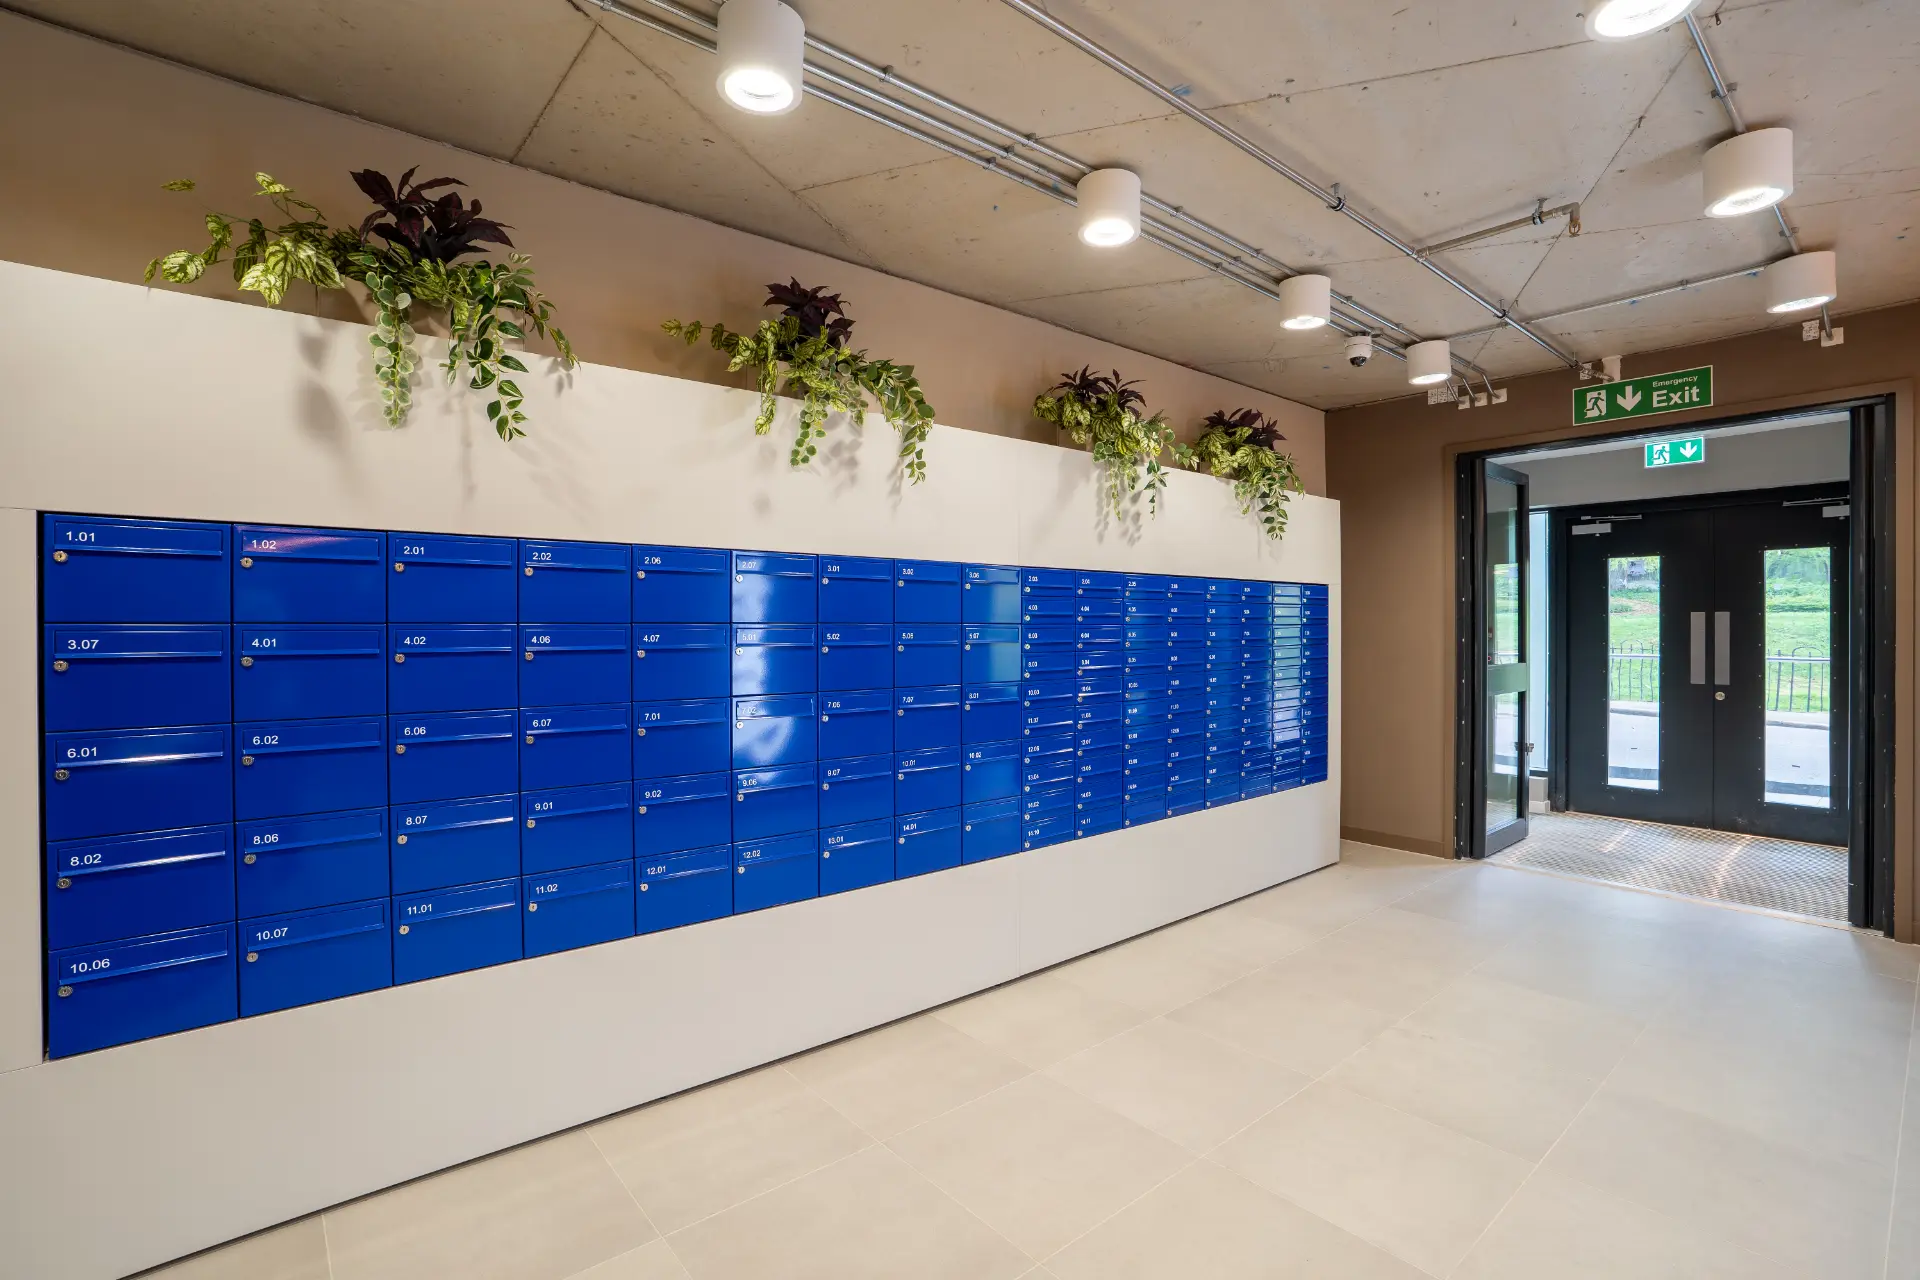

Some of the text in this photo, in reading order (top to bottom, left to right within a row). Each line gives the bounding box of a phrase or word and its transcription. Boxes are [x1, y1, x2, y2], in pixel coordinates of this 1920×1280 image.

[1652, 375, 1698, 388] Emergency
[1652, 385, 1700, 408] Exit
[67, 531, 94, 541] 1.01
[252, 539, 276, 549] 1.02
[404, 546, 424, 554] 2.01
[533, 552, 551, 560] 2.02
[742, 561, 756, 569] 2.07
[742, 633, 756, 641] 5.01
[68, 640, 99, 649] 3.07
[252, 639, 276, 647] 4.01
[533, 719, 551, 727] 6.07
[405, 727, 426, 735] 6.06
[253, 736, 278, 745] 6.02
[67, 747, 96, 758] 6.01
[742, 778, 758, 787] 9.06
[645, 790, 661, 798] 9.02
[535, 802, 552, 810] 9.01
[406, 816, 427, 825] 8.07
[904, 823, 916, 831] 14.01
[254, 834, 278, 844] 8.06
[828, 836, 843, 844] 13.01
[743, 850, 760, 858] 12.02
[71, 854, 101, 866] 8.02
[647, 866, 665, 874] 12.01
[536, 884, 557, 893] 11.02
[408, 904, 431, 914] 11.01
[256, 928, 288, 940] 10.07
[71, 959, 110, 973] 10.06
